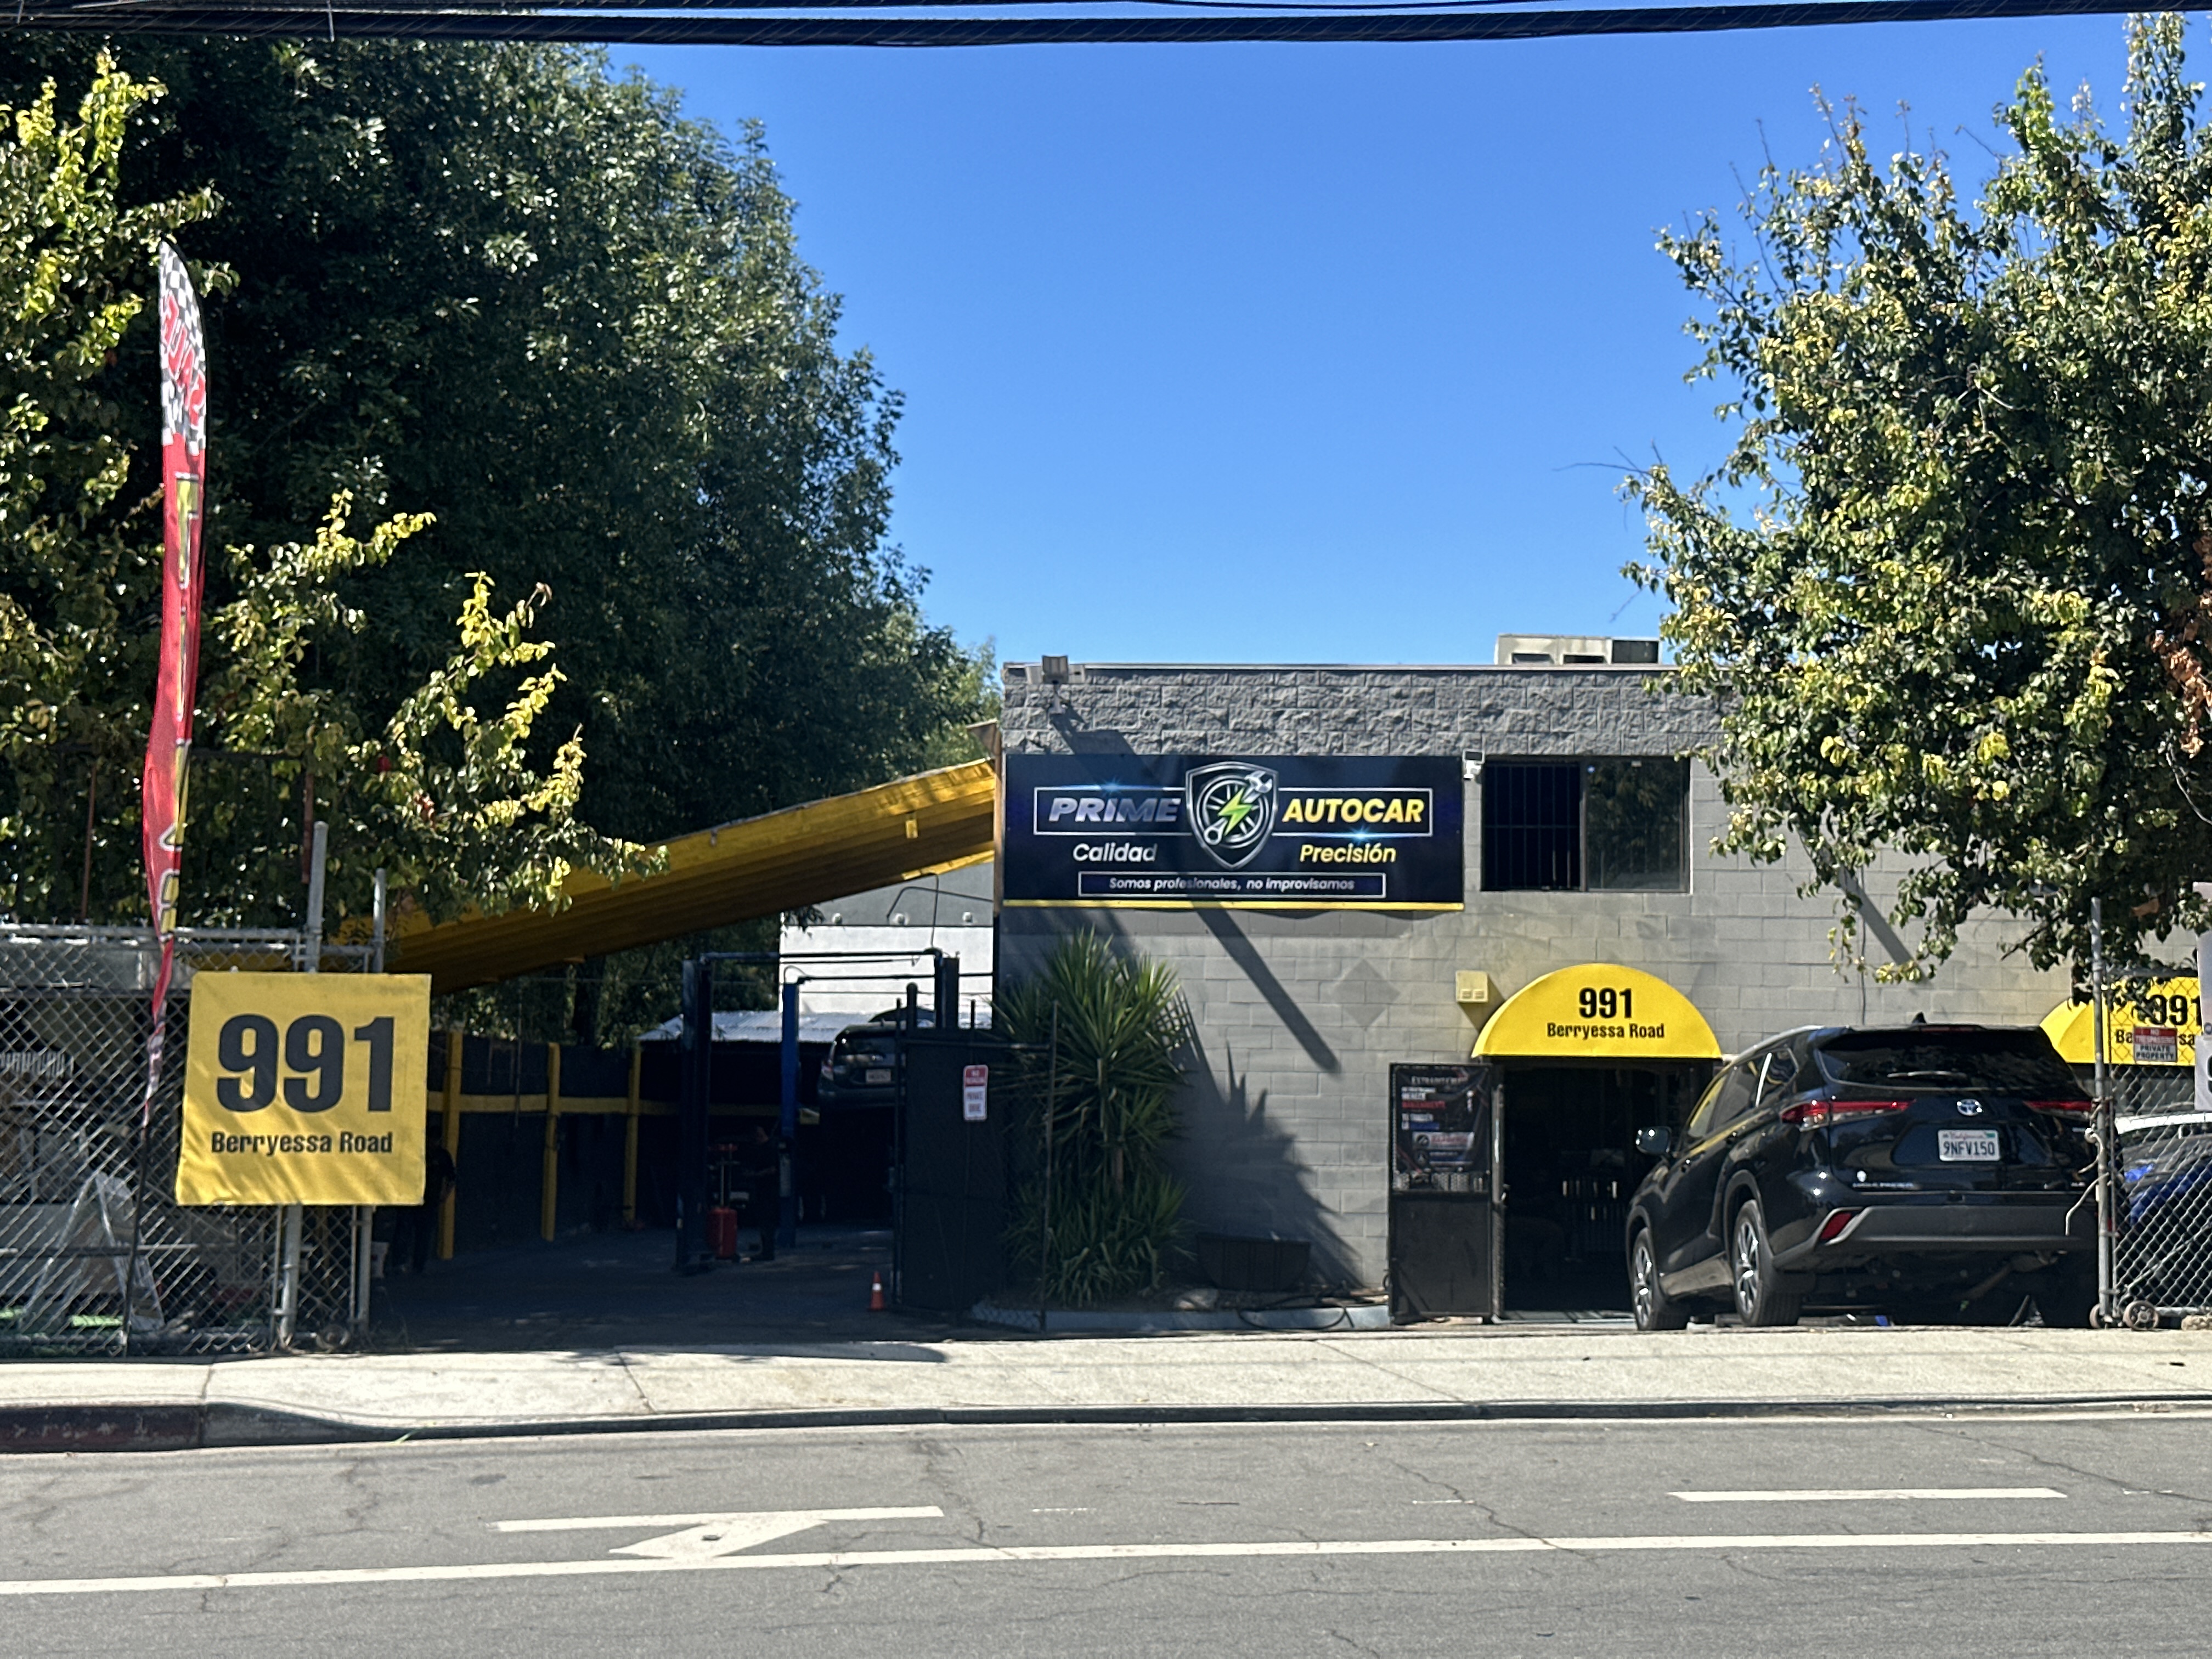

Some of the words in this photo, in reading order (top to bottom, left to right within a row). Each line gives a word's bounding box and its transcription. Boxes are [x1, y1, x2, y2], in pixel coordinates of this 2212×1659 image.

[1048, 797, 1182, 822] PRIME
[1282, 798, 1425, 823] AUTOCAR
[1073, 842, 1158, 862] Calidad
[1299, 842, 1397, 864] Precisión
[1109, 877, 1152, 889] Somos
[1153, 877, 1242, 893] profesionales,
[1246, 879, 1263, 890] no
[1265, 877, 1355, 893] improvisamos
[1579, 987, 1632, 1019] 991
[1547, 1022, 1625, 1041] Berryessa
[1629, 1023, 1665, 1039] Road
[216, 1013, 395, 1113] 991
[2136, 1052, 2174, 1060] PROPERTY
[211, 1131, 332, 1156] Berryessa
[339, 1131, 393, 1154] Road
[1943, 1141, 1995, 1156] 9NFV150
